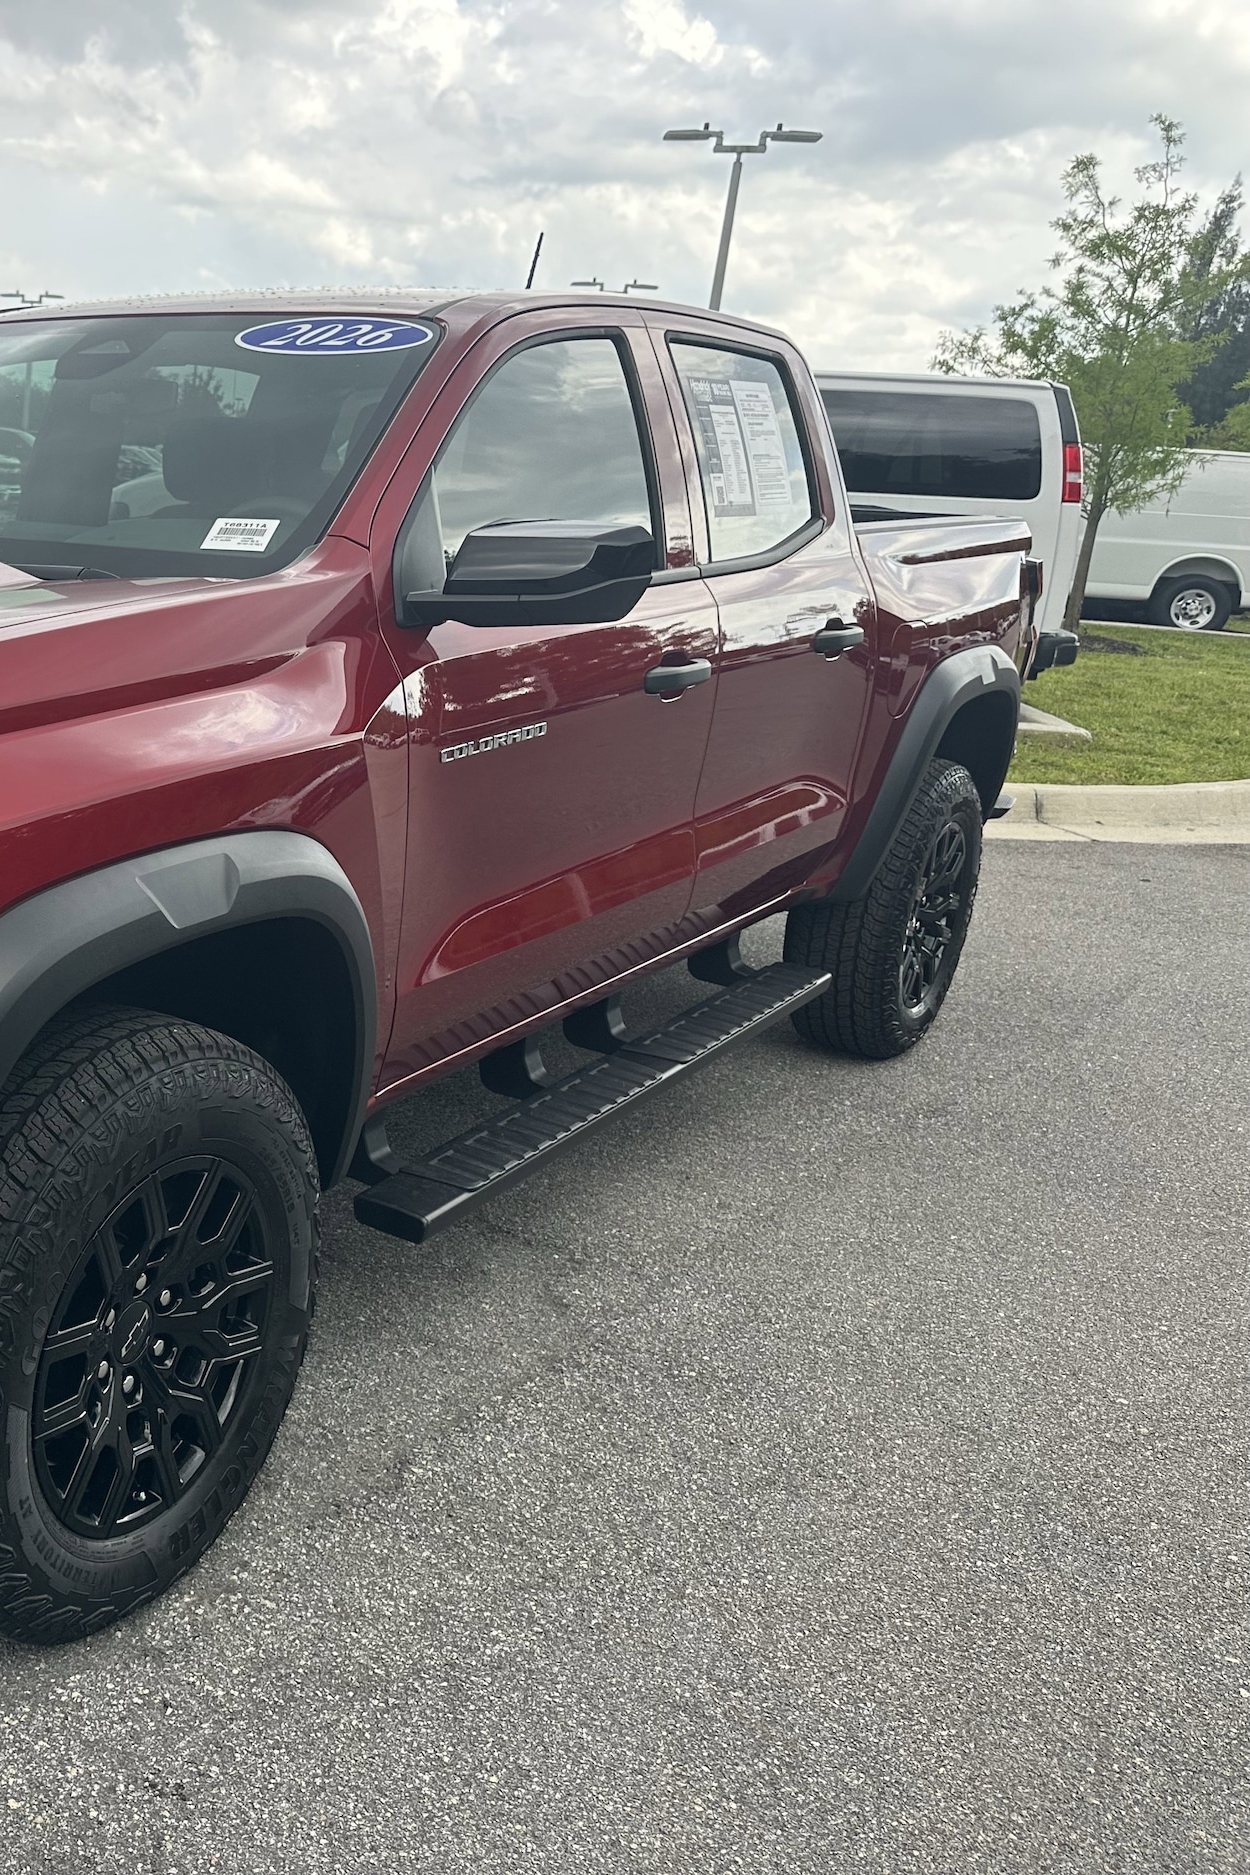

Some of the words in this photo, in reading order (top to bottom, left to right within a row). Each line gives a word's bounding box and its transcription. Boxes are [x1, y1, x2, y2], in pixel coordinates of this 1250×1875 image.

[259, 323, 412, 347] 2026
[440, 721, 548, 763] COLORADO
[167, 1334, 300, 1558] WRANGLER
